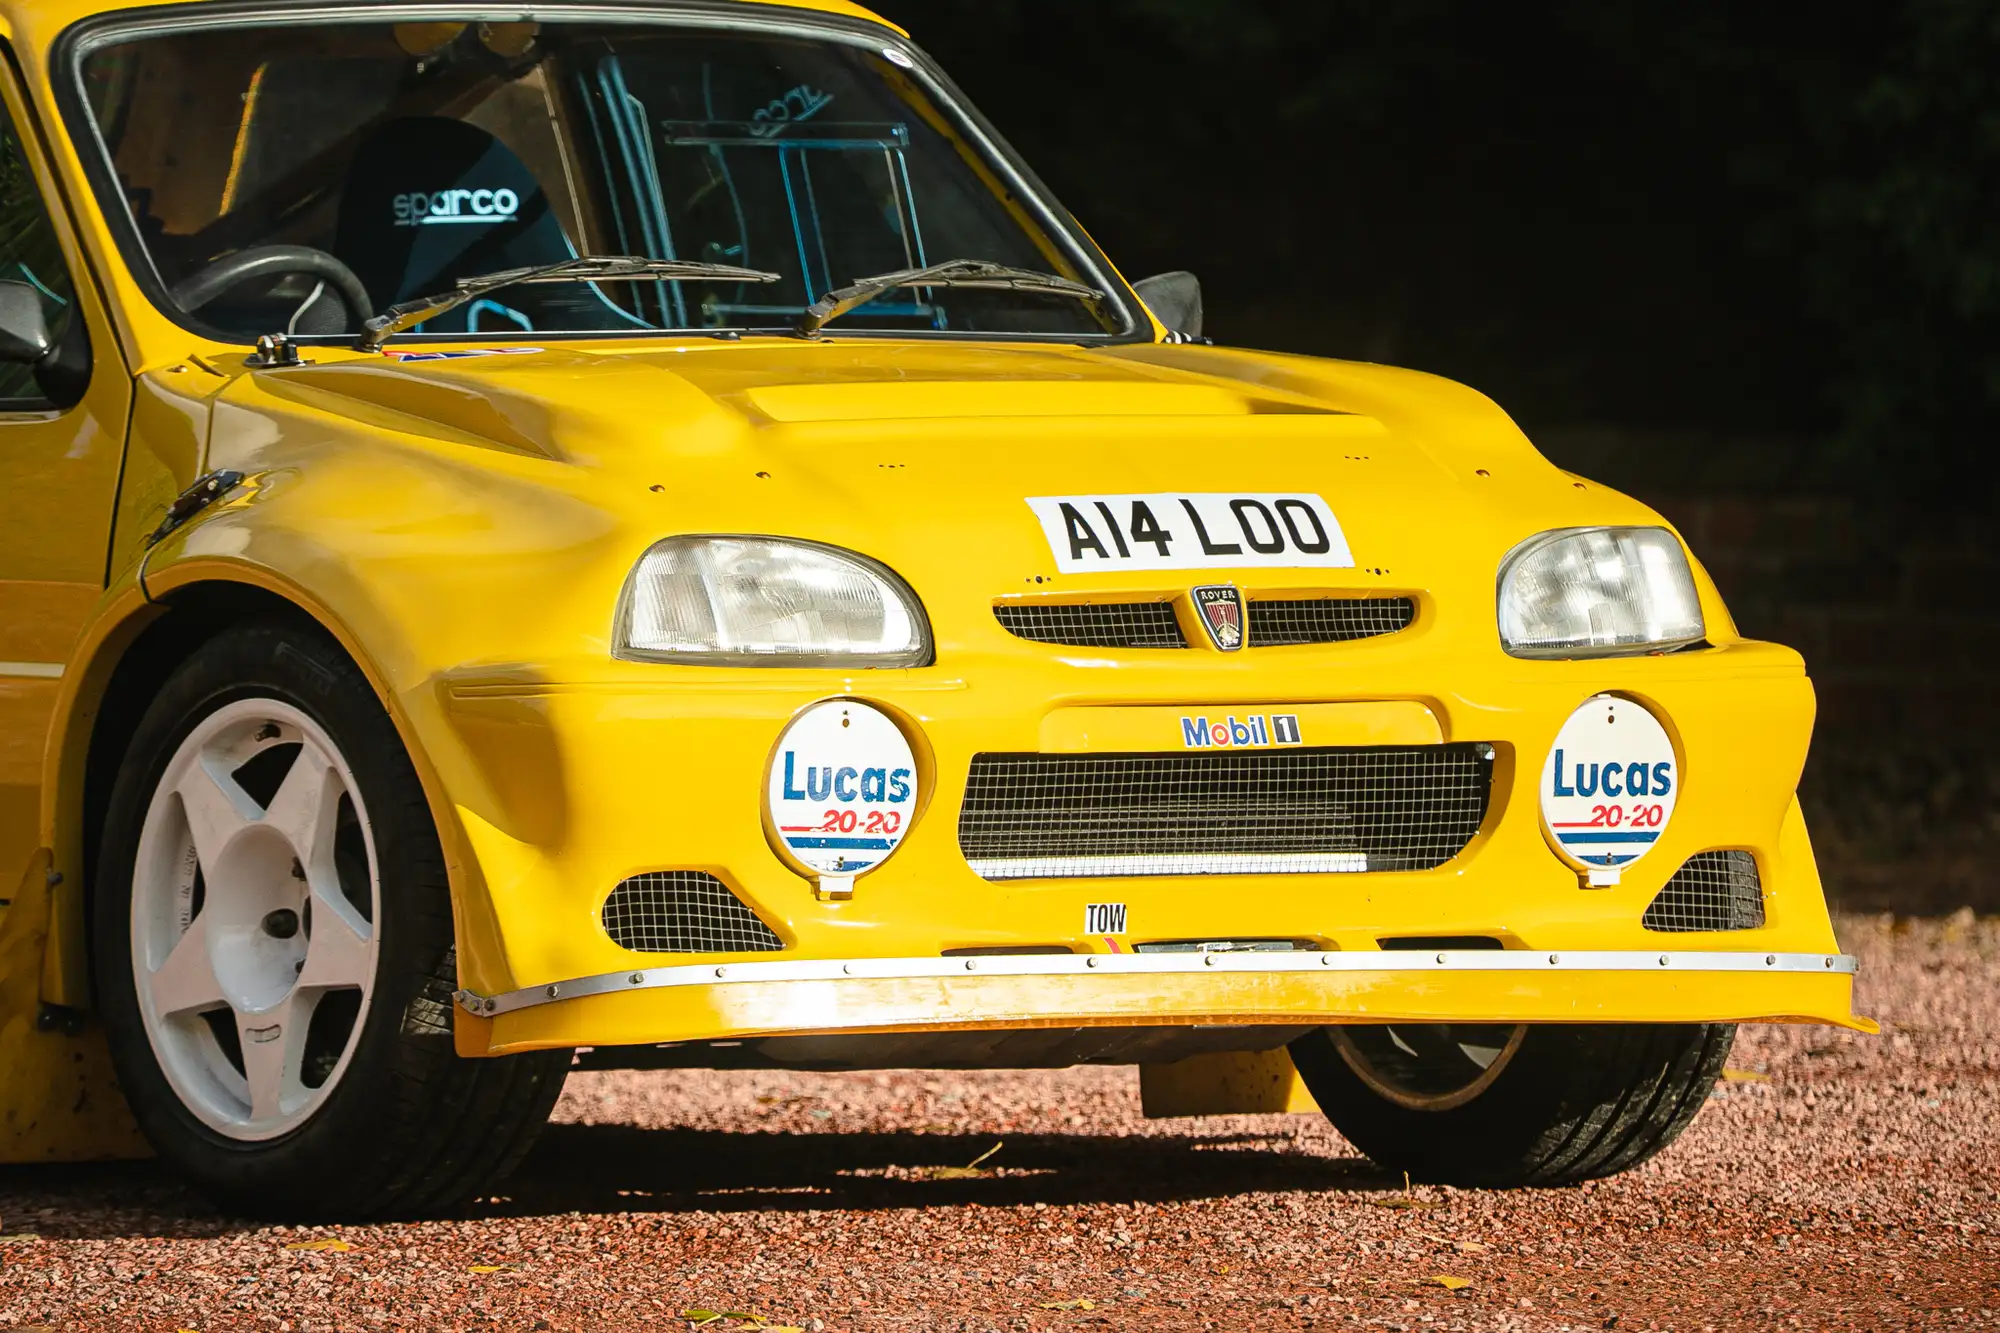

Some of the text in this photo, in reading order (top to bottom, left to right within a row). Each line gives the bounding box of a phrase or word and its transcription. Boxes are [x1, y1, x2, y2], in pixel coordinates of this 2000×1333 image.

[393, 188, 519, 226] sparco
[1058, 498, 1331, 560] A14 LOO
[1200, 590, 1236, 600] ROVER
[1182, 716, 1297, 746] Mobil 1
[783, 751, 911, 803] Lucas
[1553, 749, 1671, 797] Lucas
[822, 809, 901, 834] 20-20
[1590, 804, 1663, 828] 20-20
[1087, 904, 1127, 933] TOW
